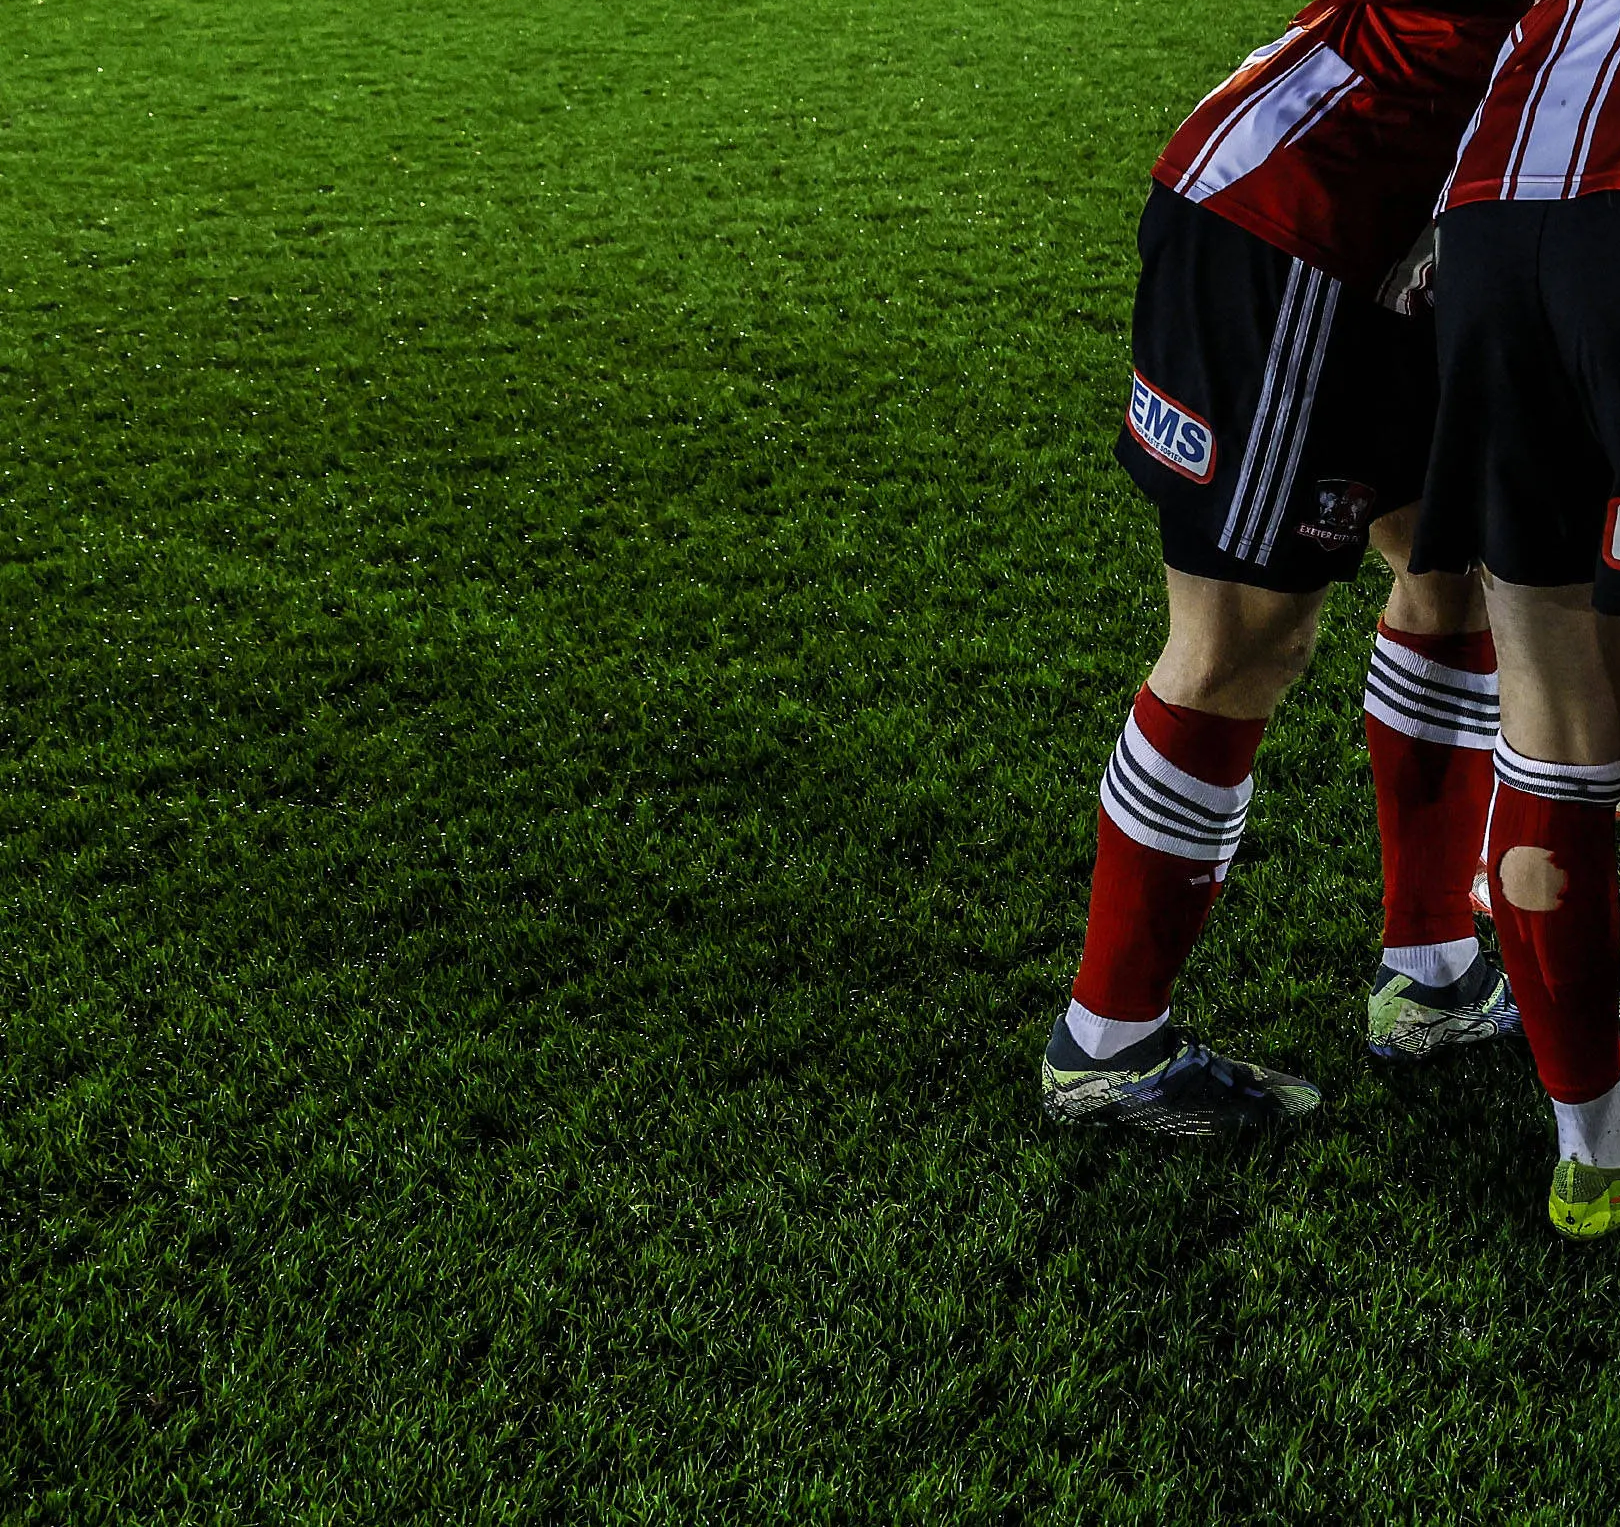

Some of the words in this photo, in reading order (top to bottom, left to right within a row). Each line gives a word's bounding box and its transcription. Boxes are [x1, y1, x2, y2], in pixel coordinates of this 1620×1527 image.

[1131, 379, 1208, 463] EMS
[1160, 445, 1183, 463] SORTED
[1299, 524, 1332, 539] EXETER
